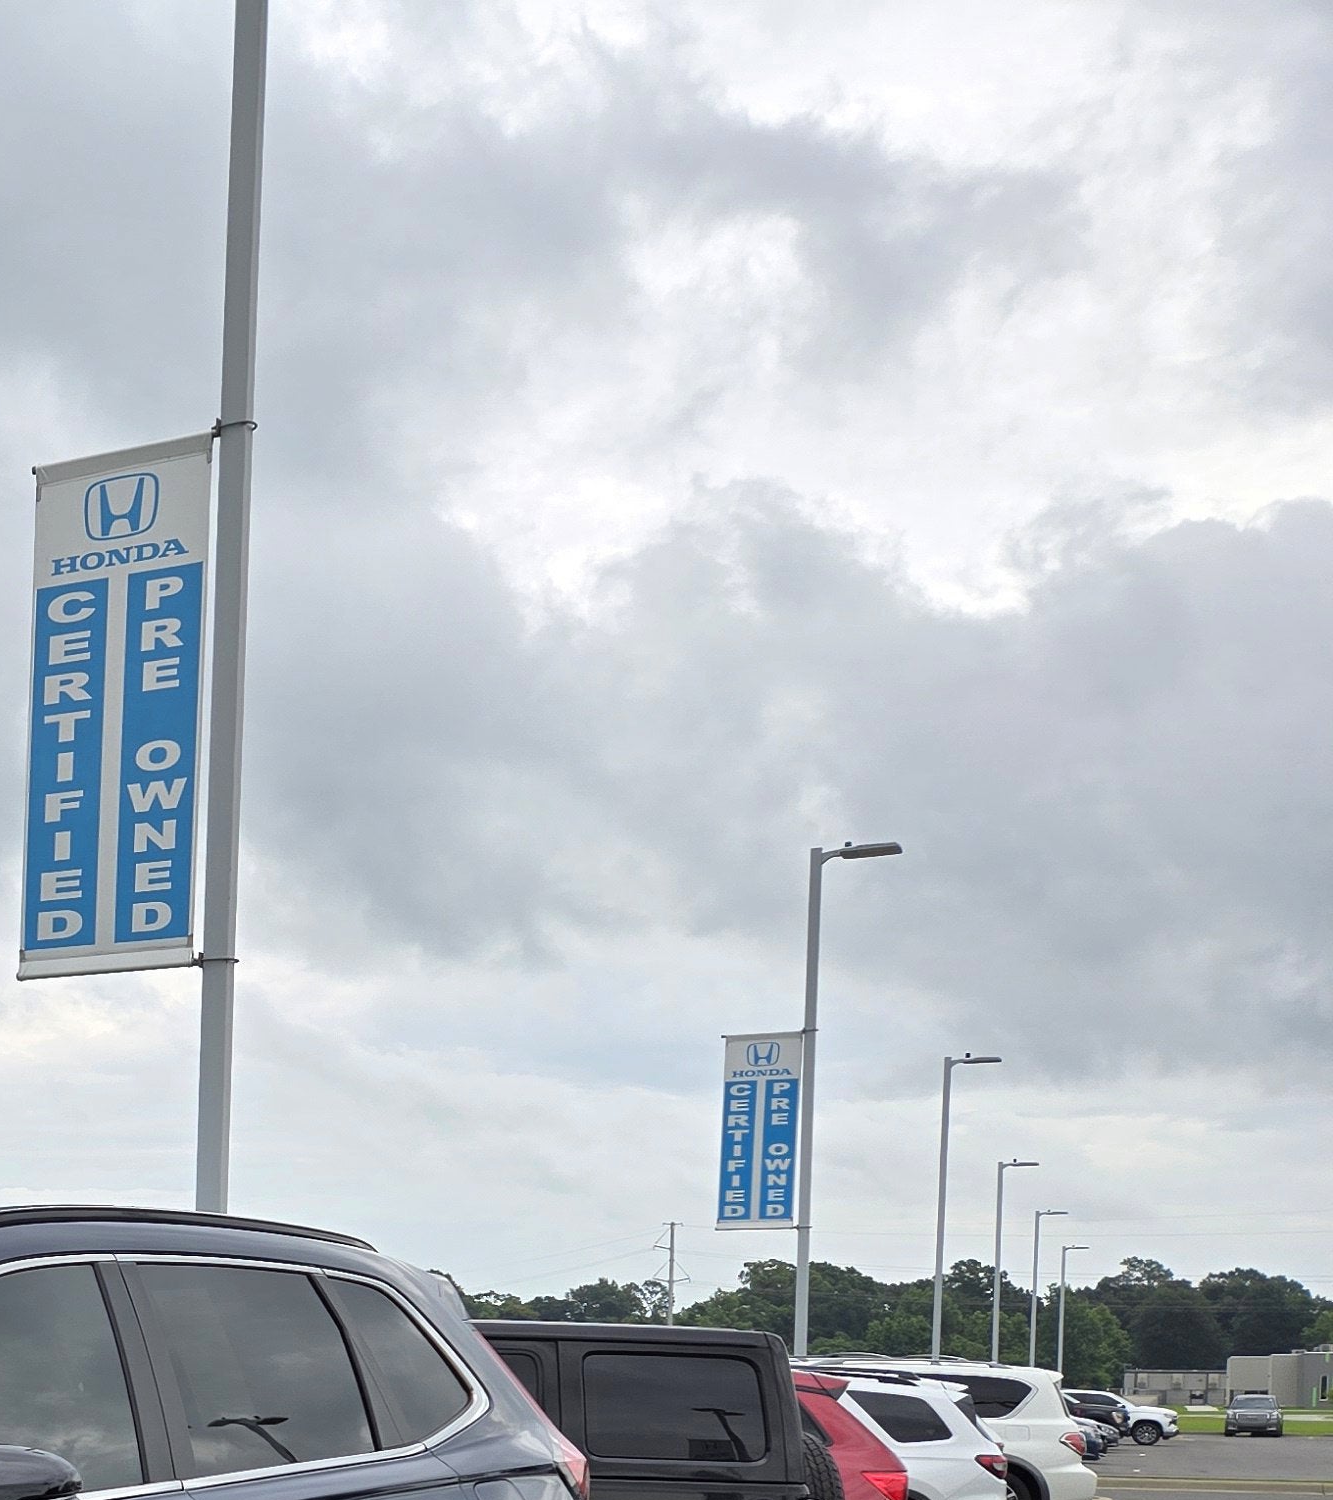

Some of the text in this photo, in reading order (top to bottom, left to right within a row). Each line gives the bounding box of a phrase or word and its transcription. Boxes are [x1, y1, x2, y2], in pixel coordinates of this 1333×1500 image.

[51, 538, 189, 576] HONDA
[37, 590, 96, 941] CERTIFIED
[127, 576, 187, 933] PRE OWNED
[732, 1069, 792, 1078] HONDA
[724, 1084, 752, 1217] CERTIFIED
[764, 1082, 791, 1216] PRE OWNED
